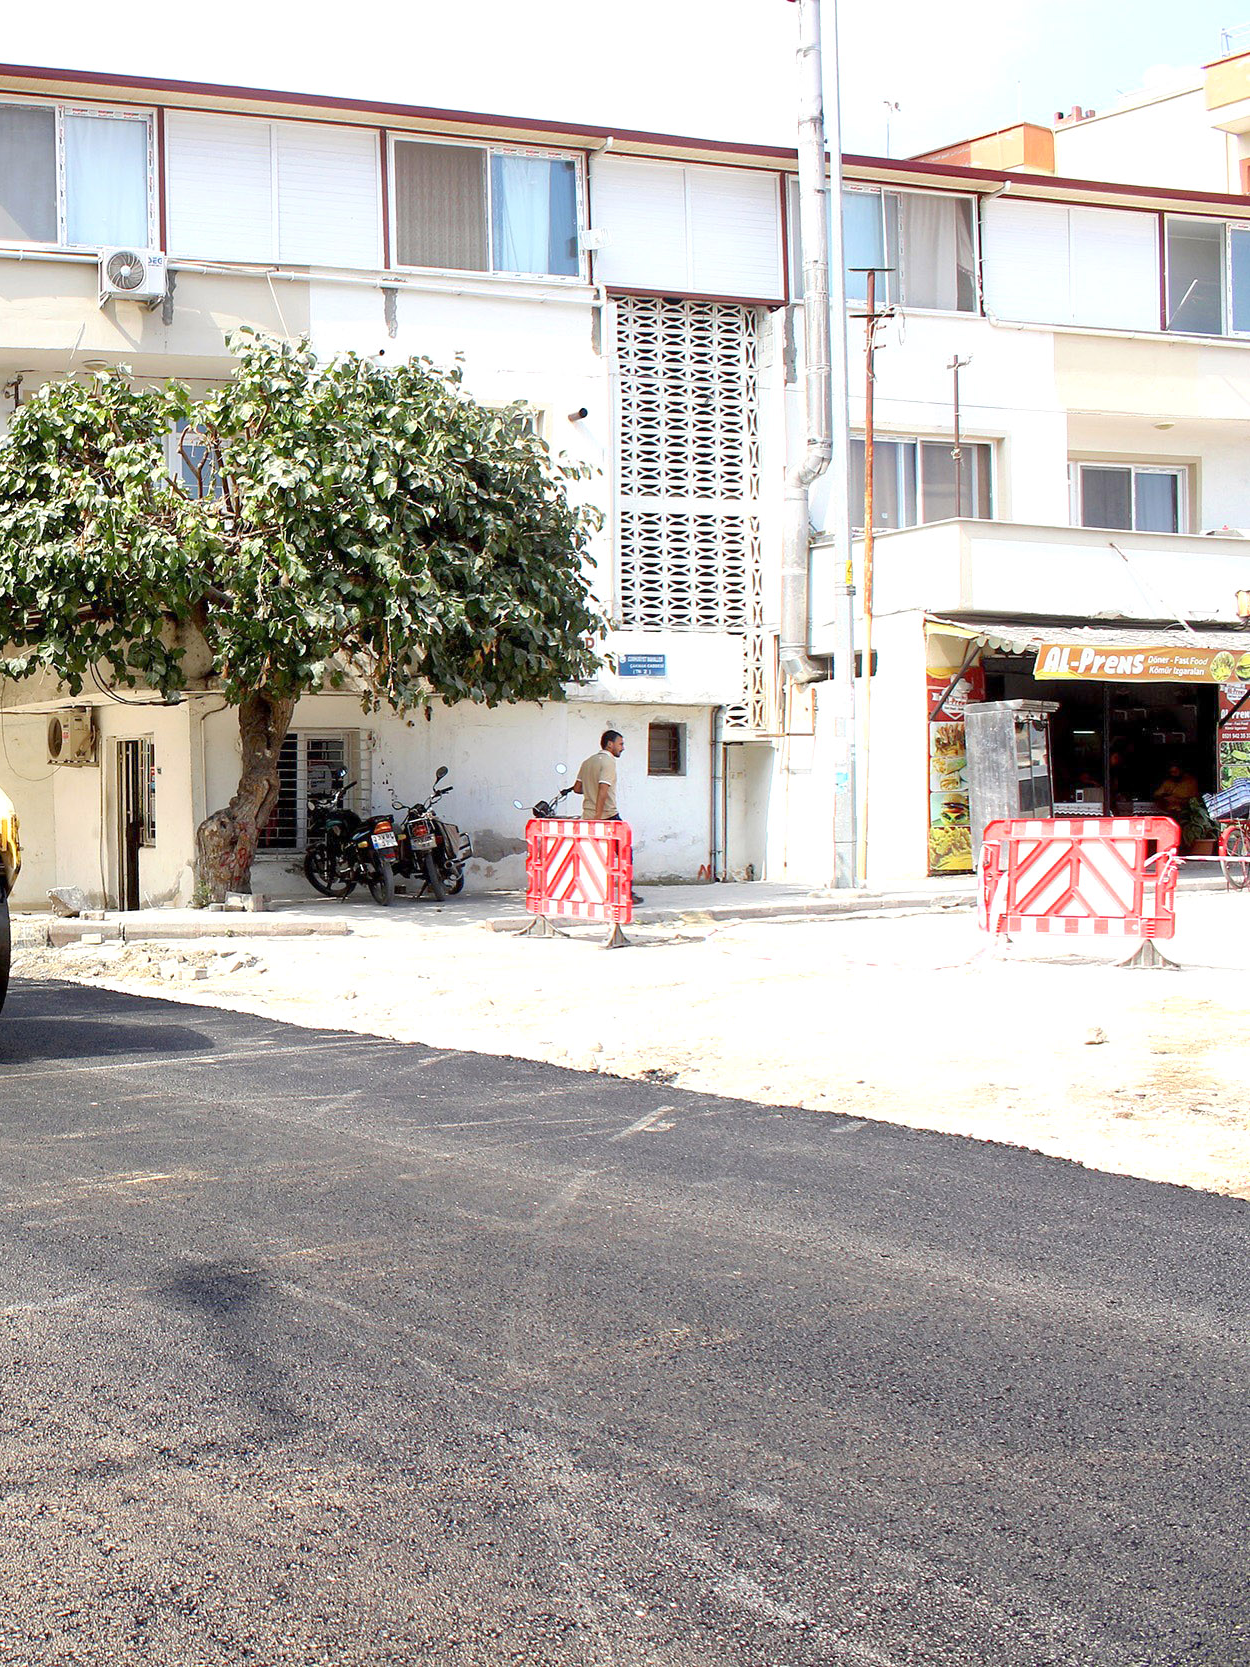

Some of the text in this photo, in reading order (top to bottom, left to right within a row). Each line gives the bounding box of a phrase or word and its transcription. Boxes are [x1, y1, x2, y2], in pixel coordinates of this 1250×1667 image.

[1148, 655, 1170, 664] Döner
[1174, 656, 1190, 665] Fast
[1190, 656, 1209, 666] Food
[1149, 665, 1172, 675] Kömür
